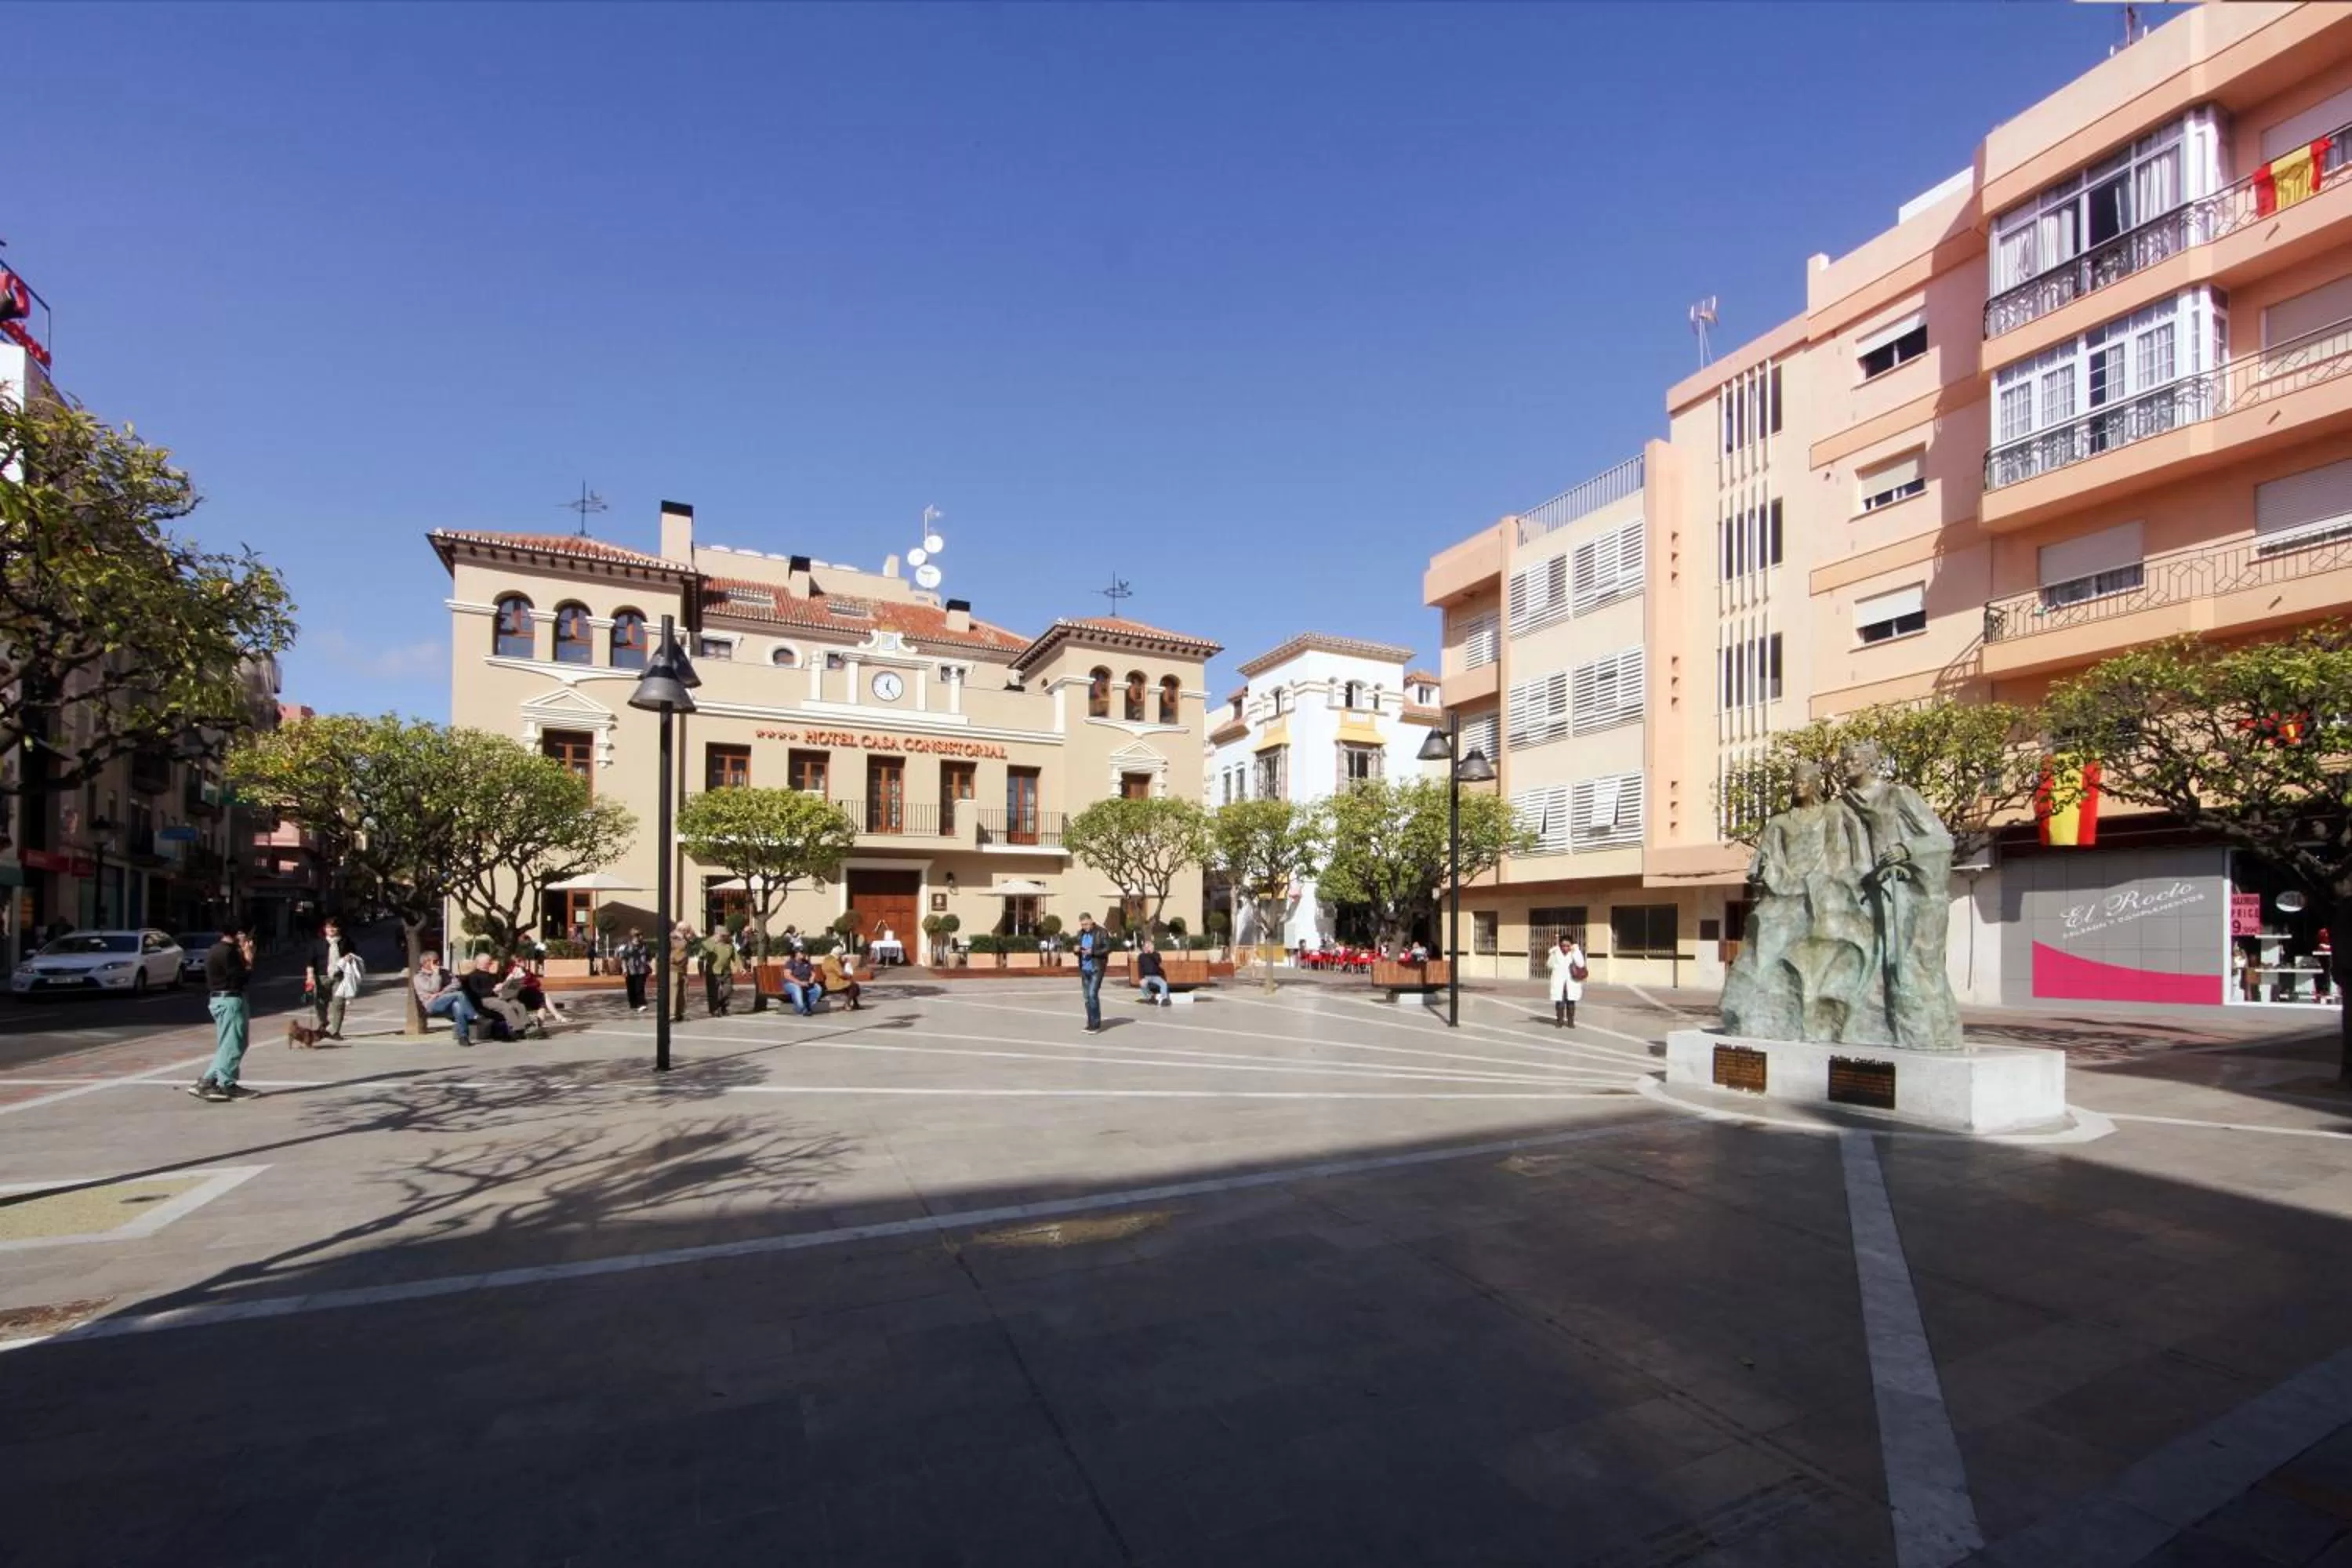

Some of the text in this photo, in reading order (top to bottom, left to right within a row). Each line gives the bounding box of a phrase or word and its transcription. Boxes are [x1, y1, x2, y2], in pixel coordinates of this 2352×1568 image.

[804, 729, 1008, 760] HOTEL CASA CONSISTORIAL
[2059, 904, 2096, 928] El
